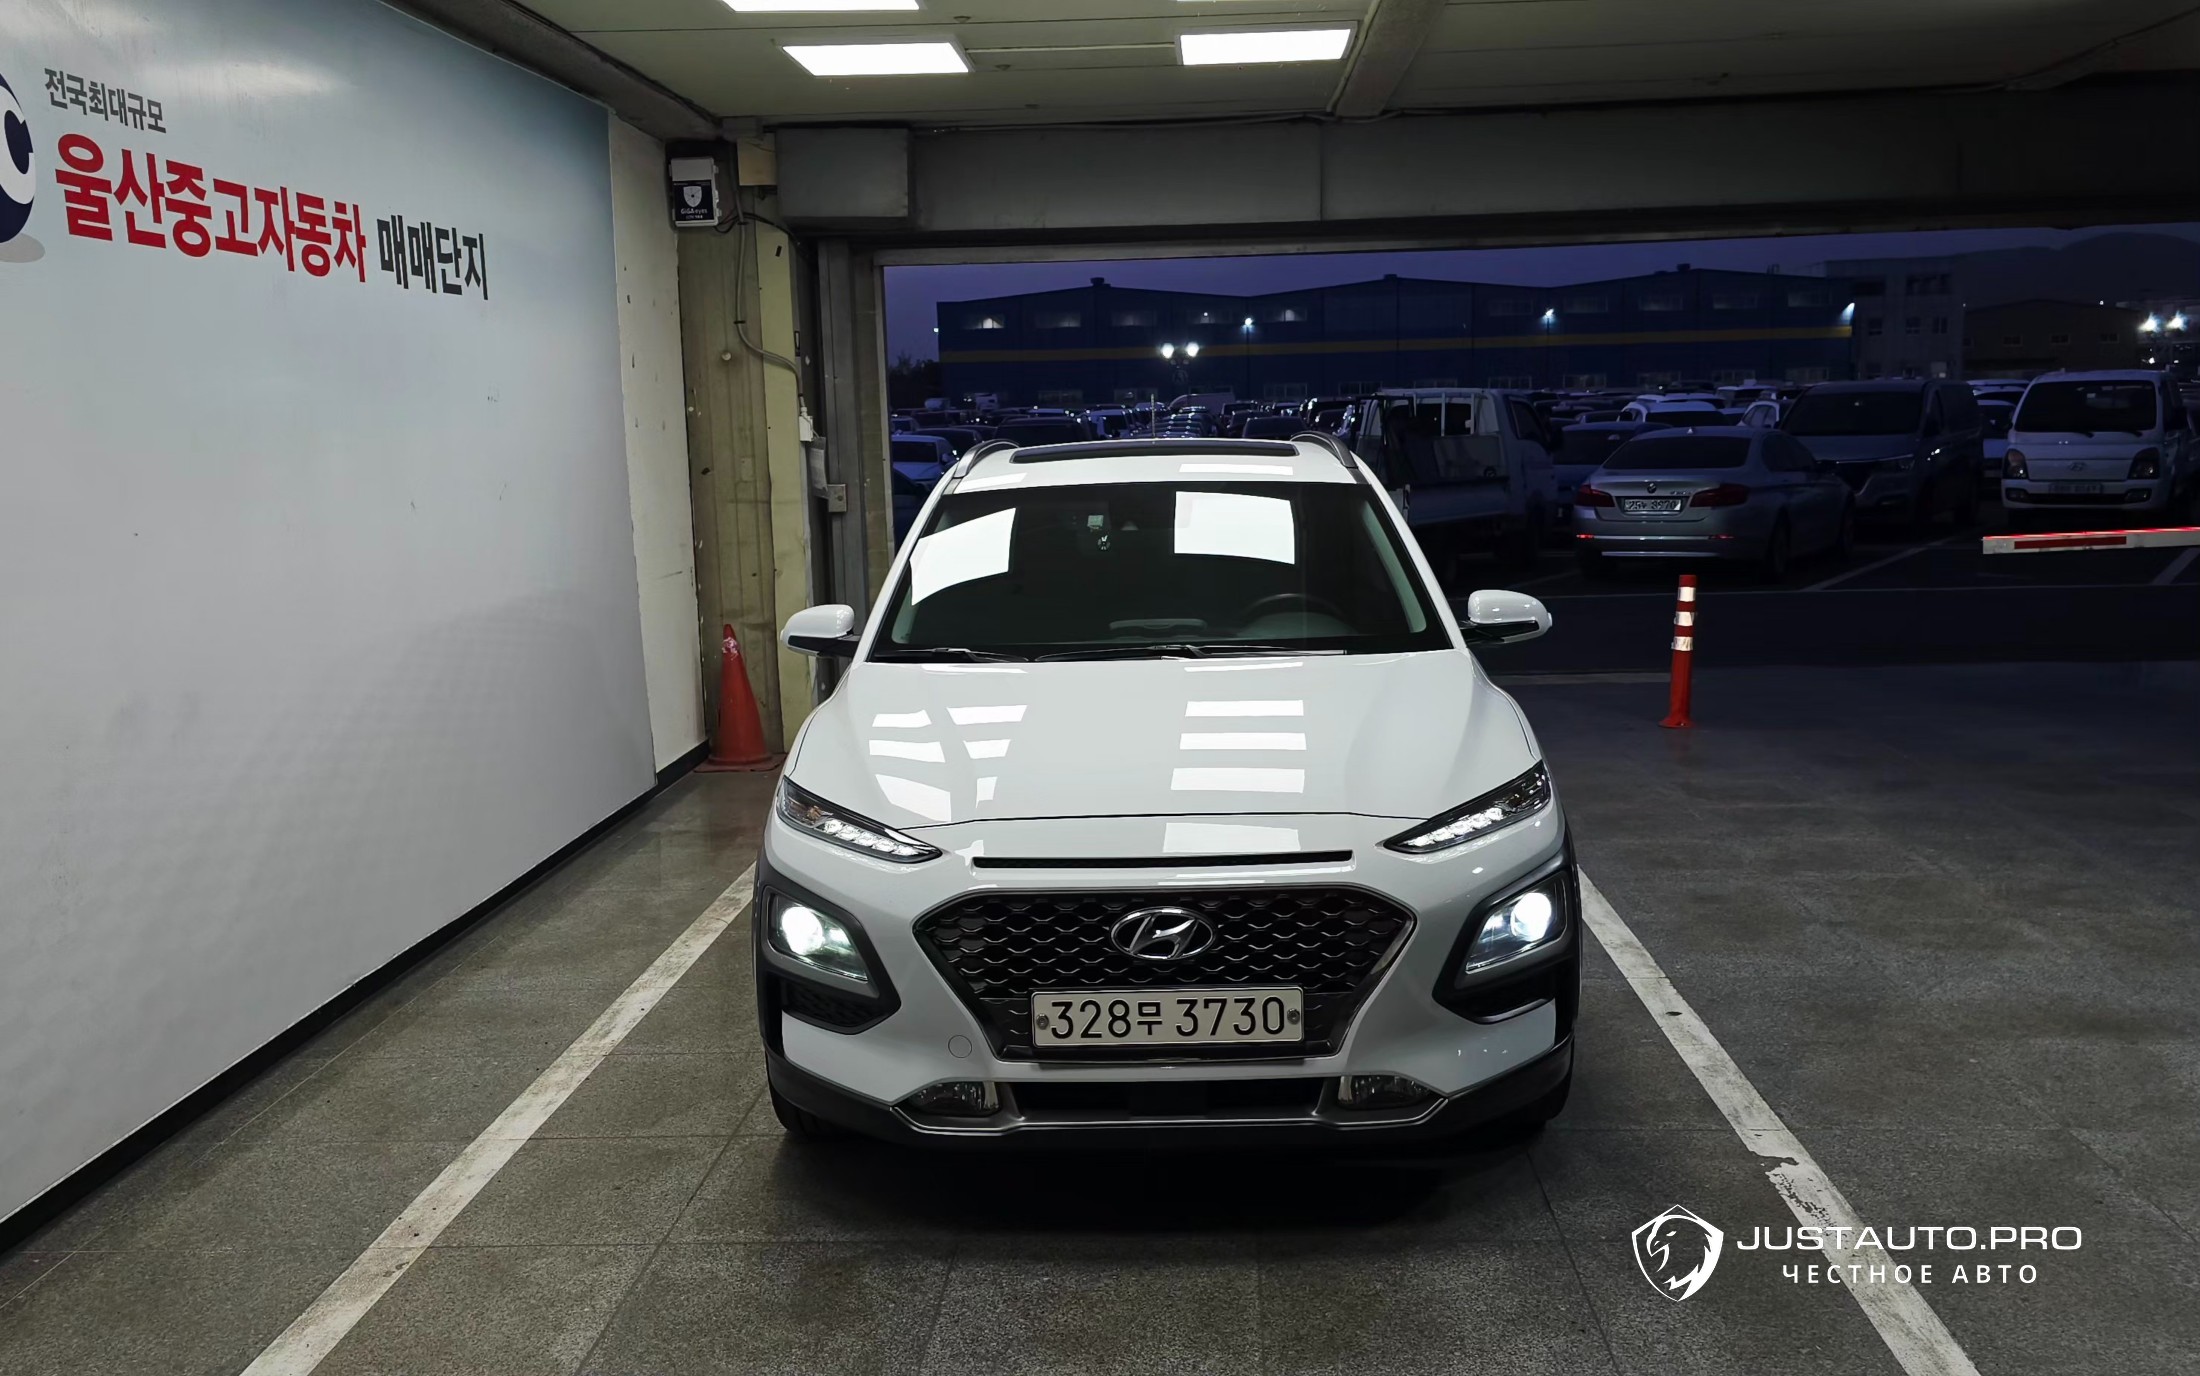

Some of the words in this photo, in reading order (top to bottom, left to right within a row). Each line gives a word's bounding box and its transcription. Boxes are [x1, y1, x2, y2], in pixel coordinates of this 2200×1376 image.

[44, 67, 167, 134] 전국최대규모
[55, 133, 366, 282] 울산중고자동차
[376, 214, 488, 300] 매매단지
[1051, 999, 1162, 1039] 328무
[1176, 996, 1285, 1036] 3730
